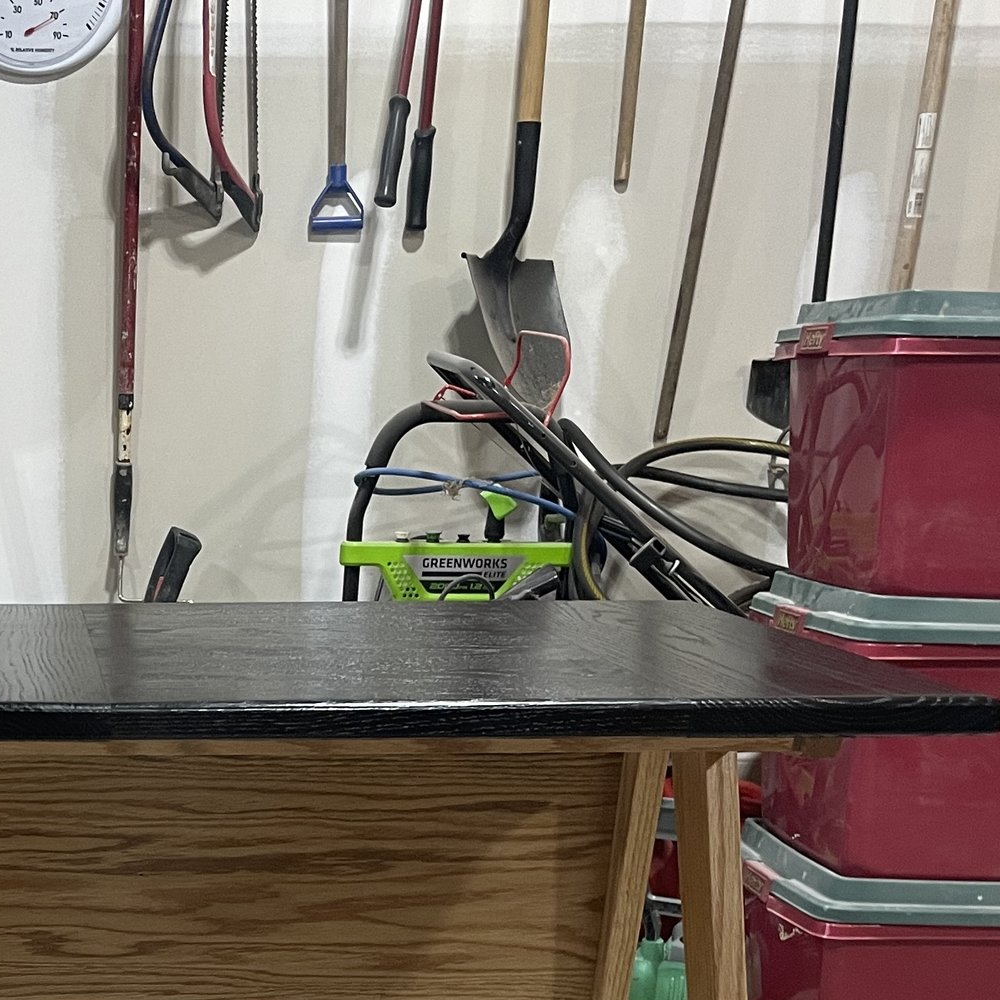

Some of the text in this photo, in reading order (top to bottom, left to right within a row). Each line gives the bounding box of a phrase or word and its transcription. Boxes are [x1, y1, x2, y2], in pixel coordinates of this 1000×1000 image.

[13, 5, 22, 14] 30
[50, 11, 59, 20] 70
[5, 30, 13, 39] 10
[53, 31, 62, 40] 90
[422, 557, 508, 569] GREENWORKS
